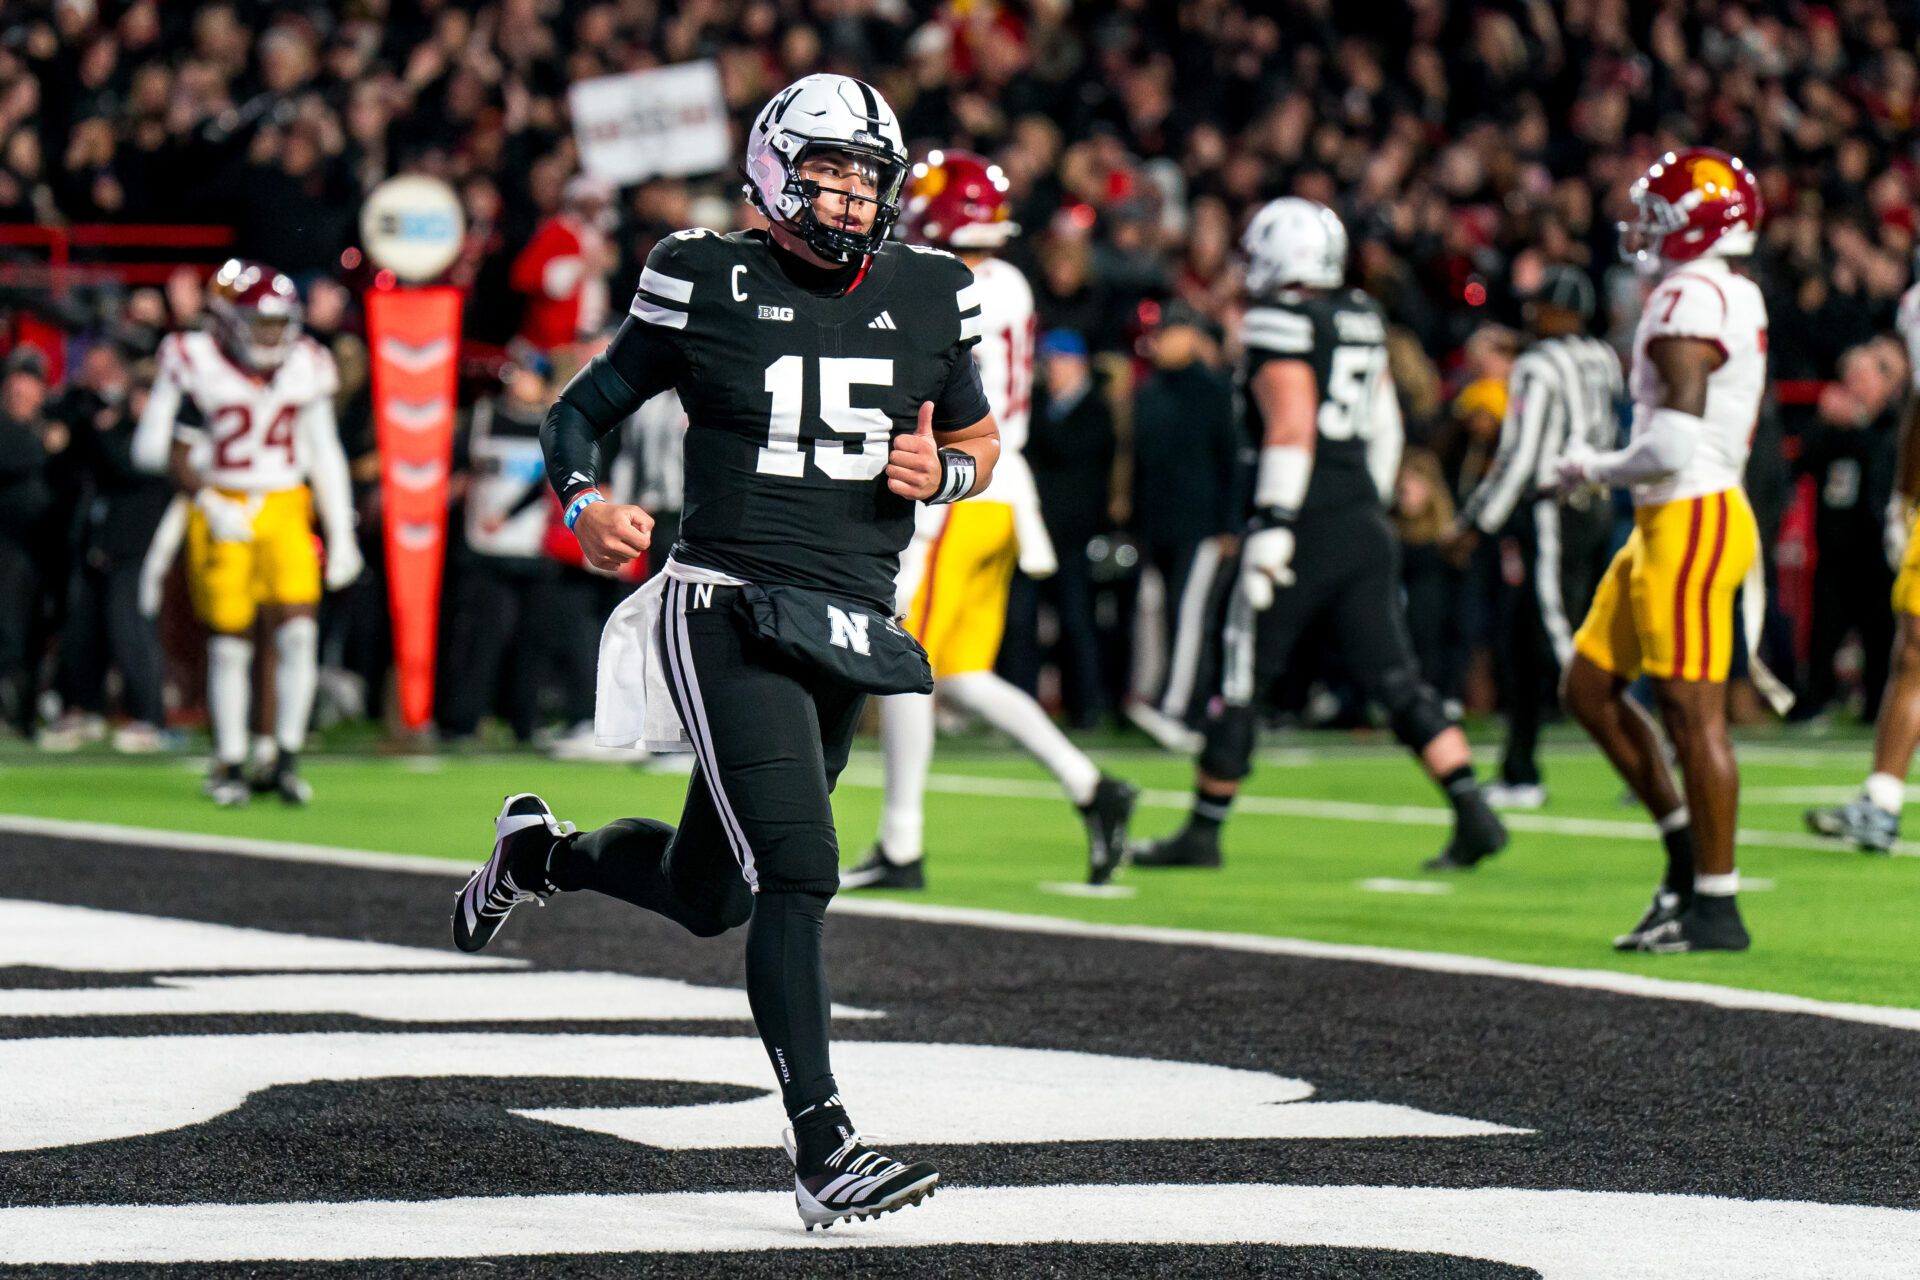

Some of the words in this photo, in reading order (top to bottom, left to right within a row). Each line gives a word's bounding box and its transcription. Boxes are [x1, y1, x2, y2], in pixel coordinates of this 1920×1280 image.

[731, 264, 748, 302] C
[1662, 288, 1683, 323] 7
[214, 403, 299, 468] 24
[756, 355, 893, 480] 15
[694, 584, 714, 609] N
[827, 605, 871, 656] N
[775, 1046, 790, 1084] TECHFIT
